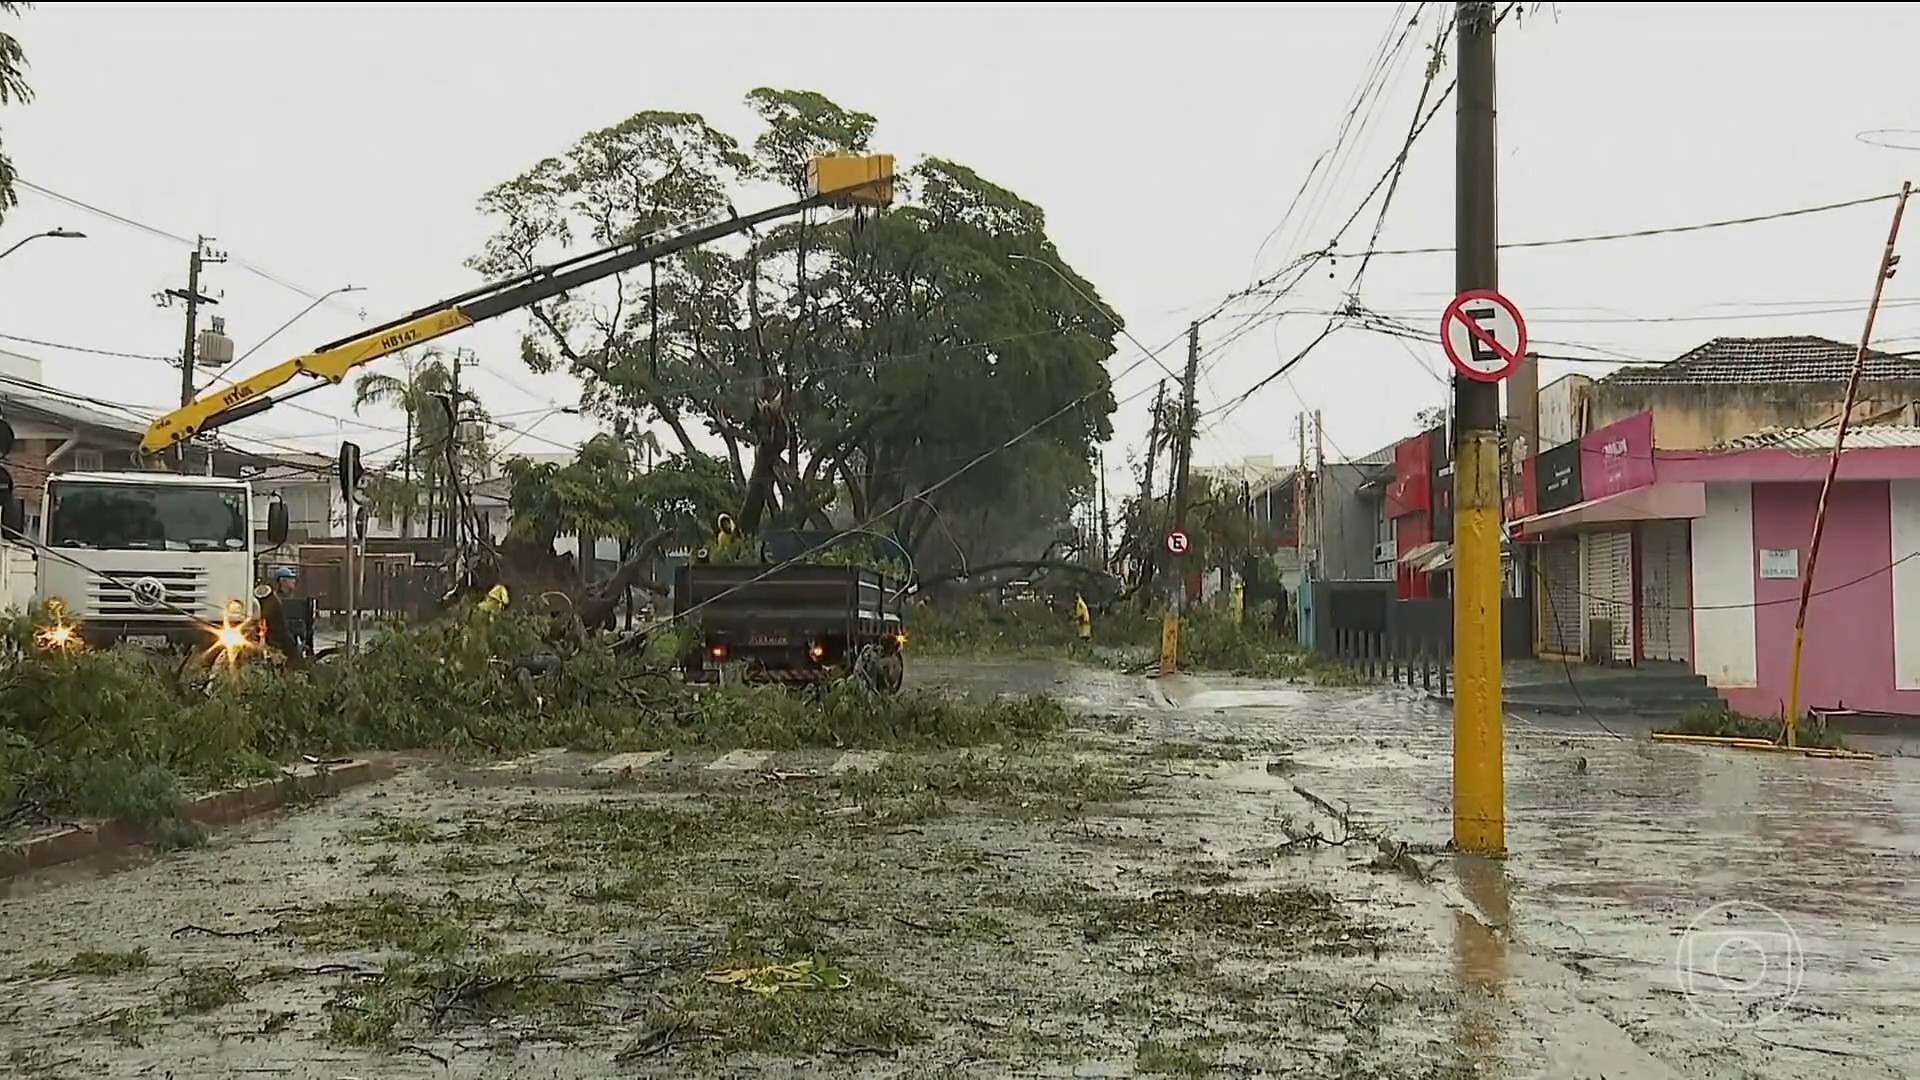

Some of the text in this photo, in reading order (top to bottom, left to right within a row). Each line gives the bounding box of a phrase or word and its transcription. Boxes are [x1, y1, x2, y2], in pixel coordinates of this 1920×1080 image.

[381, 329, 416, 349] HB147
[1466, 308, 1502, 361] E
[223, 386, 254, 405] HYVA
